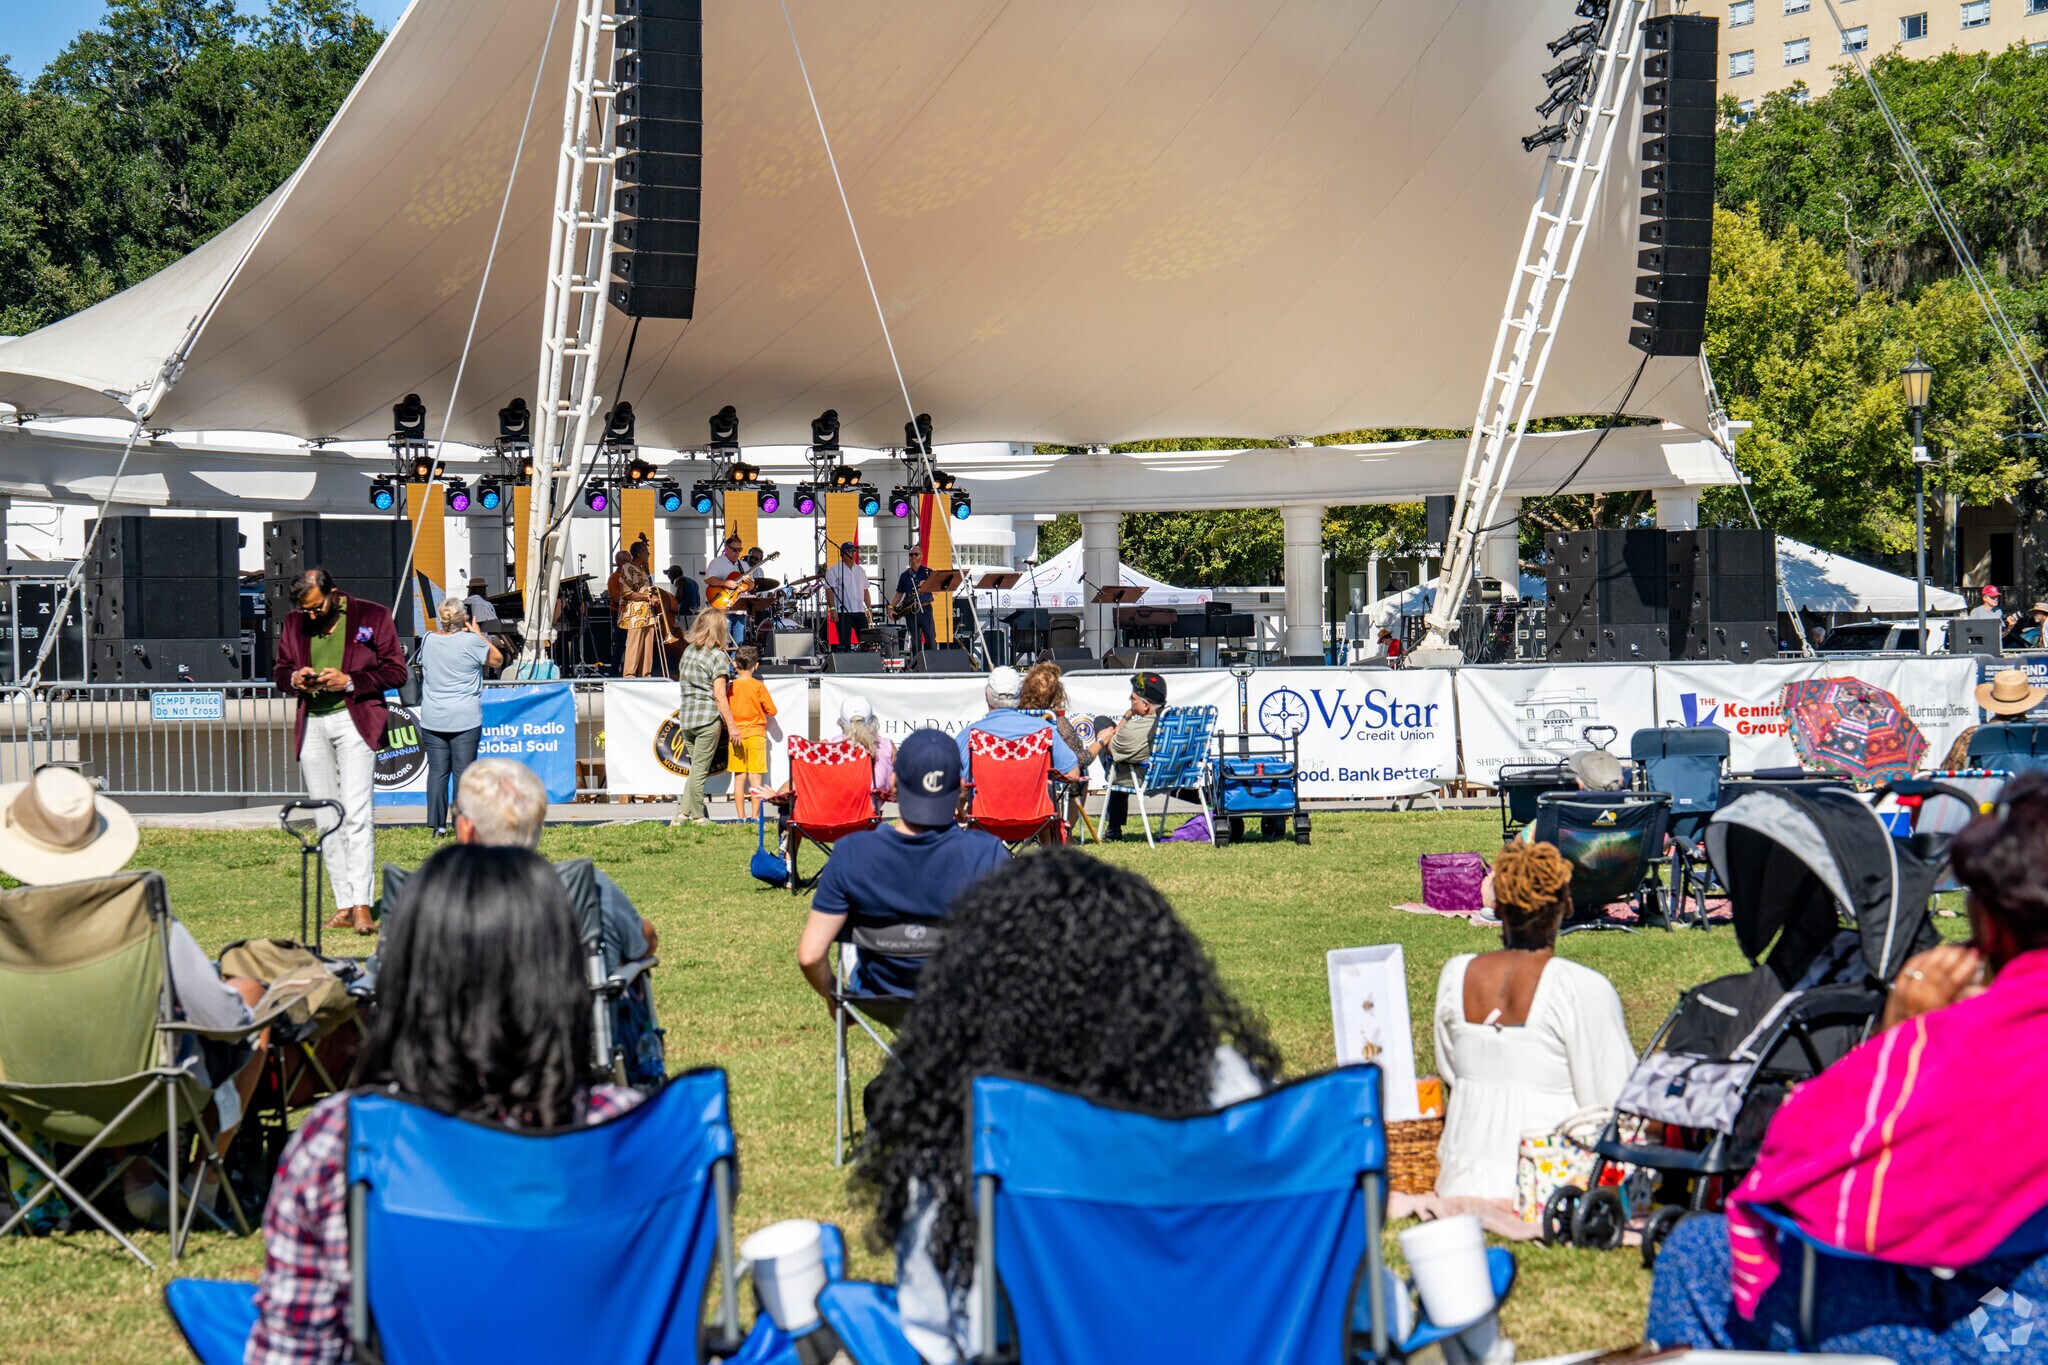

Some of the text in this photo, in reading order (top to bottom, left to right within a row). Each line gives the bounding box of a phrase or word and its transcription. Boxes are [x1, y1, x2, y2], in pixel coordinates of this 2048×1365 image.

[2020, 664, 2047, 676] FIND
[155, 696, 219, 706] SCMPD Police
[1699, 697, 1717, 706] THE
[156, 706, 219, 716] Do Not Cross
[388, 705, 411, 720] RADIO
[1309, 688, 1438, 741] VyStar
[1723, 701, 1782, 718] Kennic
[1905, 703, 1947, 719] Morning
[481, 721, 566, 738] unity Radio
[885, 718, 970, 733] HN DAV
[1736, 720, 1788, 738] Group
[1356, 730, 1435, 741] Credit Union
[377, 745, 420, 761] SAVANNAH
[477, 739, 559, 754] Global Soul
[1476, 758, 1501, 767] SHIPS
[1503, 757, 1515, 766] OF
[1516, 756, 1537, 765] THE
[373, 763, 413, 782] WRUU.ORG
[1298, 767, 1335, 782] ood.
[1339, 769, 1380, 782] Bank
